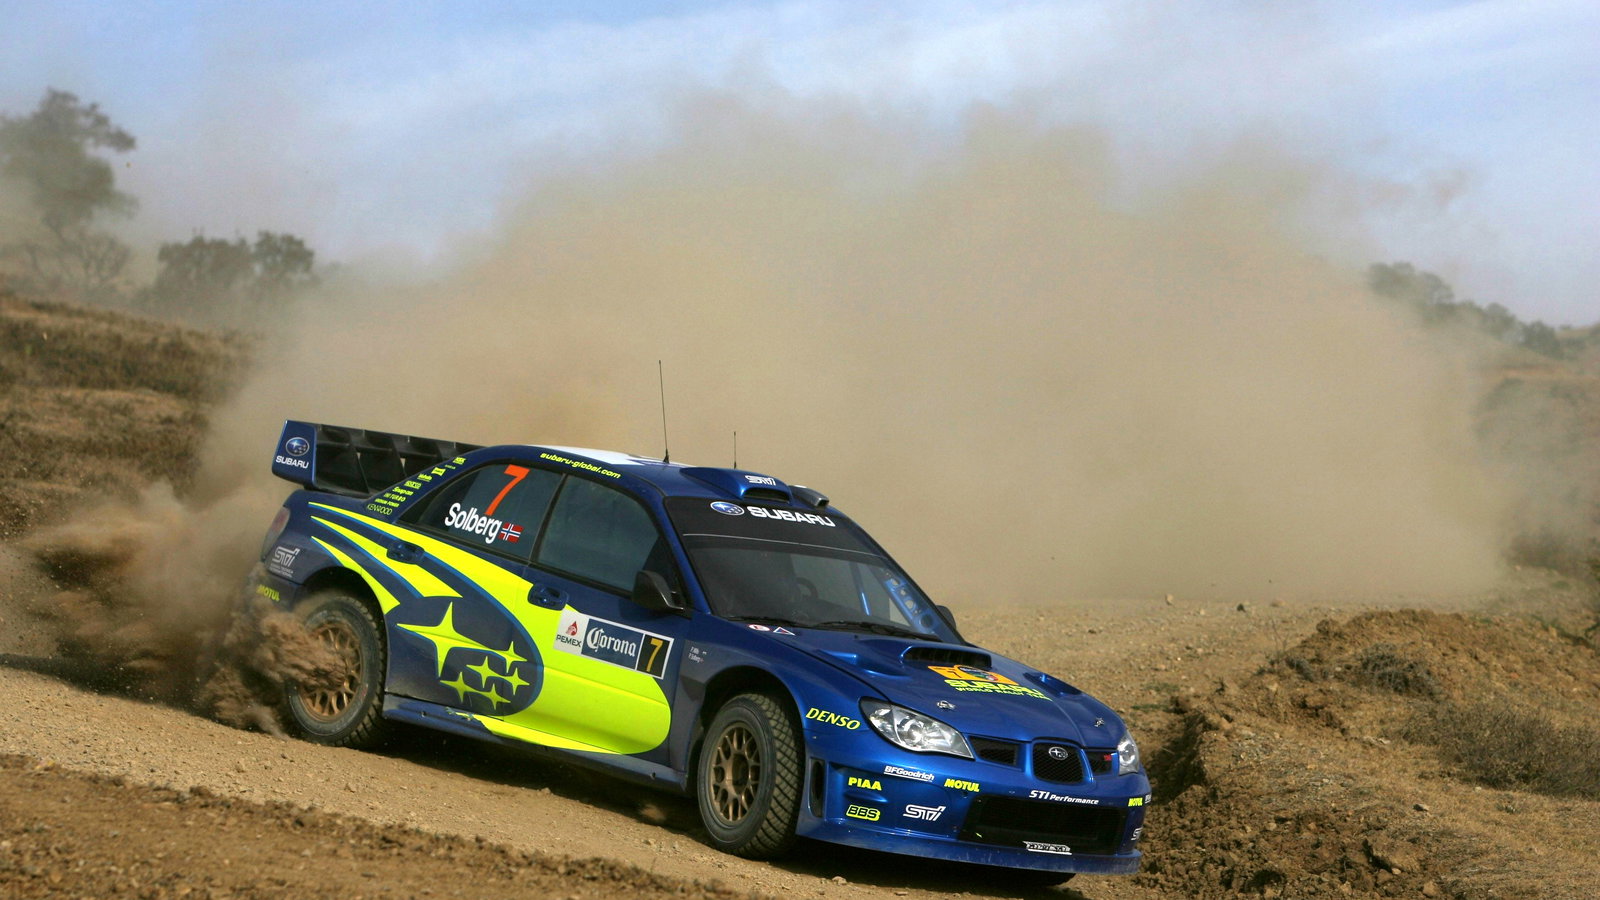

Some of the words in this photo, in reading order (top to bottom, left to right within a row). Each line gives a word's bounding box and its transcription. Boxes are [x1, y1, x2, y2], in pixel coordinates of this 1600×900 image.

[275, 455, 309, 469] SUBARU
[484, 464, 530, 516] 7
[444, 502, 502, 544] Solberg
[746, 505, 836, 527] SUBARU
[556, 634, 582, 648] PEMEX
[586, 626, 636, 658] Corona
[646, 637, 664, 672] 7
[944, 679, 1045, 696] SUBARU
[805, 706, 861, 731] DENSO
[884, 765, 935, 780] BFGoodrich
[848, 776, 883, 792] PIAA
[943, 778, 981, 793] MOTUL
[1028, 789, 1052, 801] STI
[1050, 794, 1100, 806] Performance
[847, 805, 880, 821] BBS
